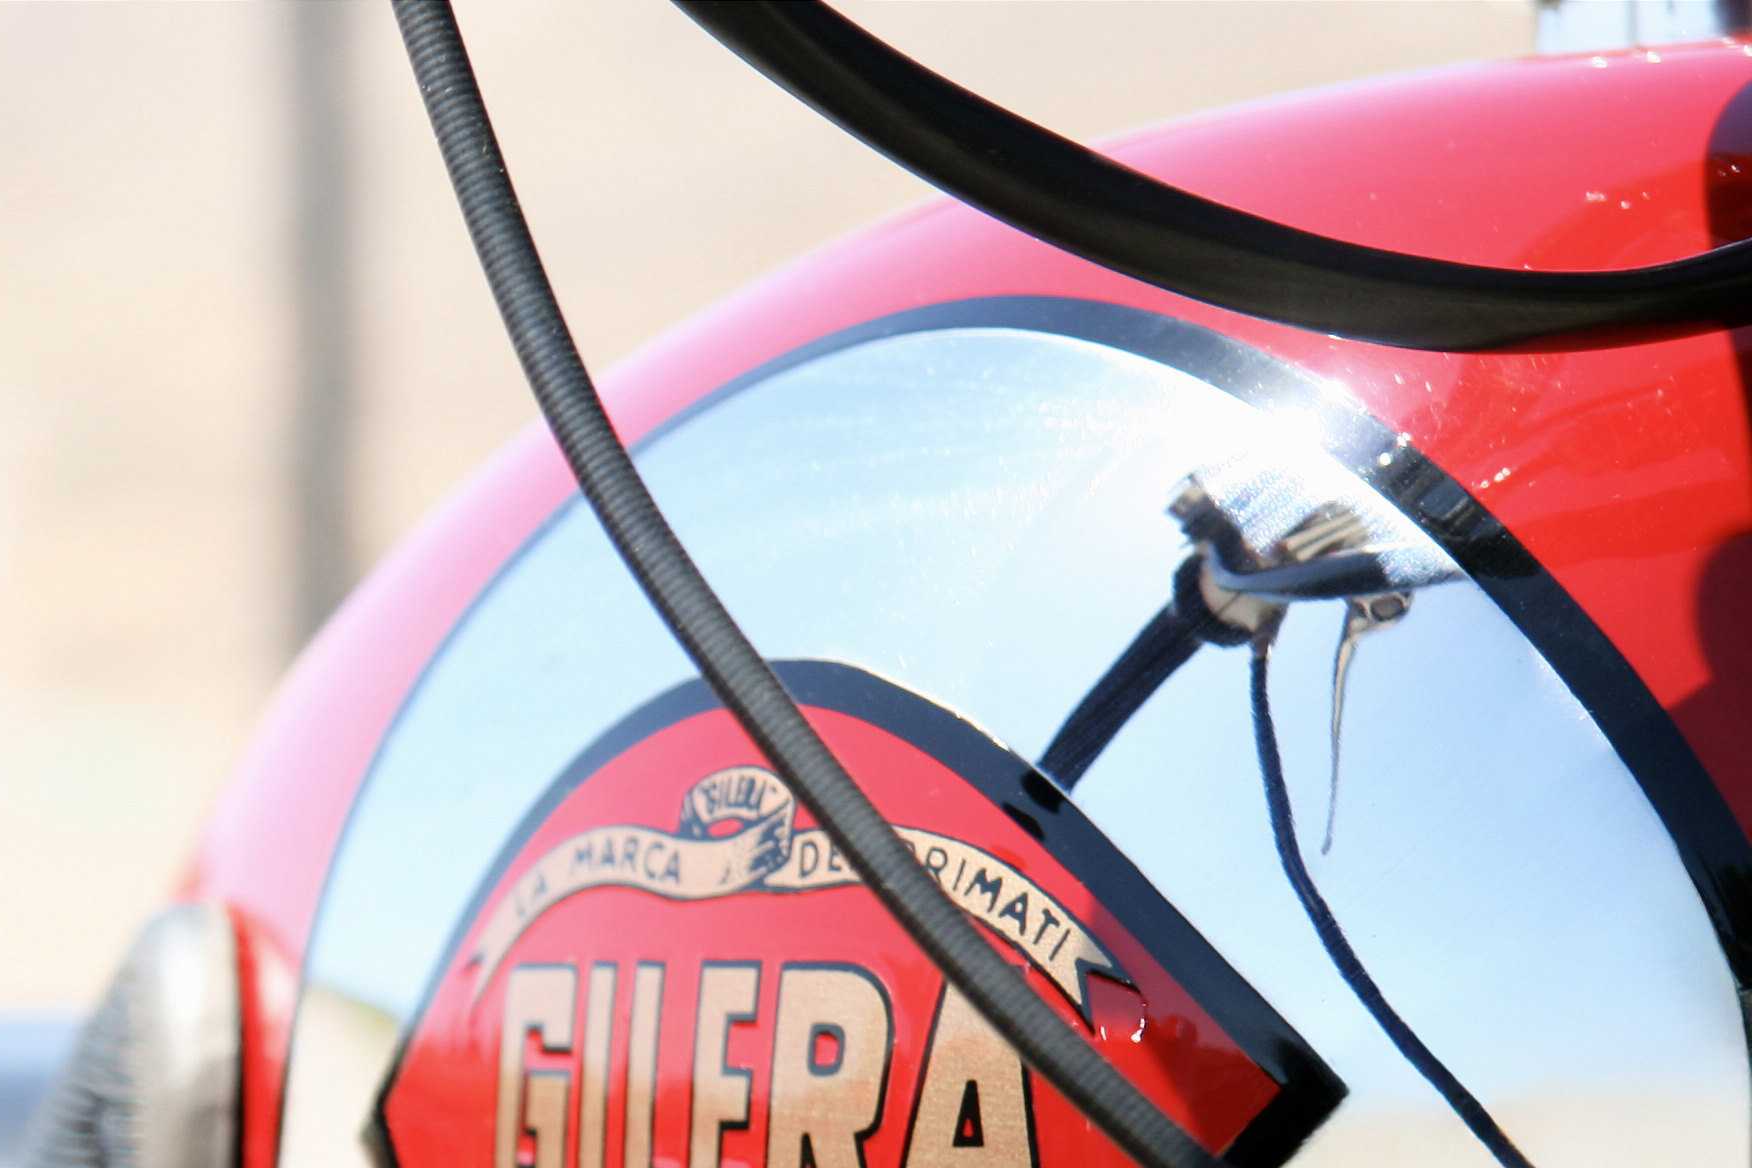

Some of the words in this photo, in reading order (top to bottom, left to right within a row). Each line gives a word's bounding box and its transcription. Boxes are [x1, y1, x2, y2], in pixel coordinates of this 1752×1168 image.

[514, 870, 548, 920] LA
[568, 835, 681, 885] MARCA
[799, 838, 856, 879] DE
